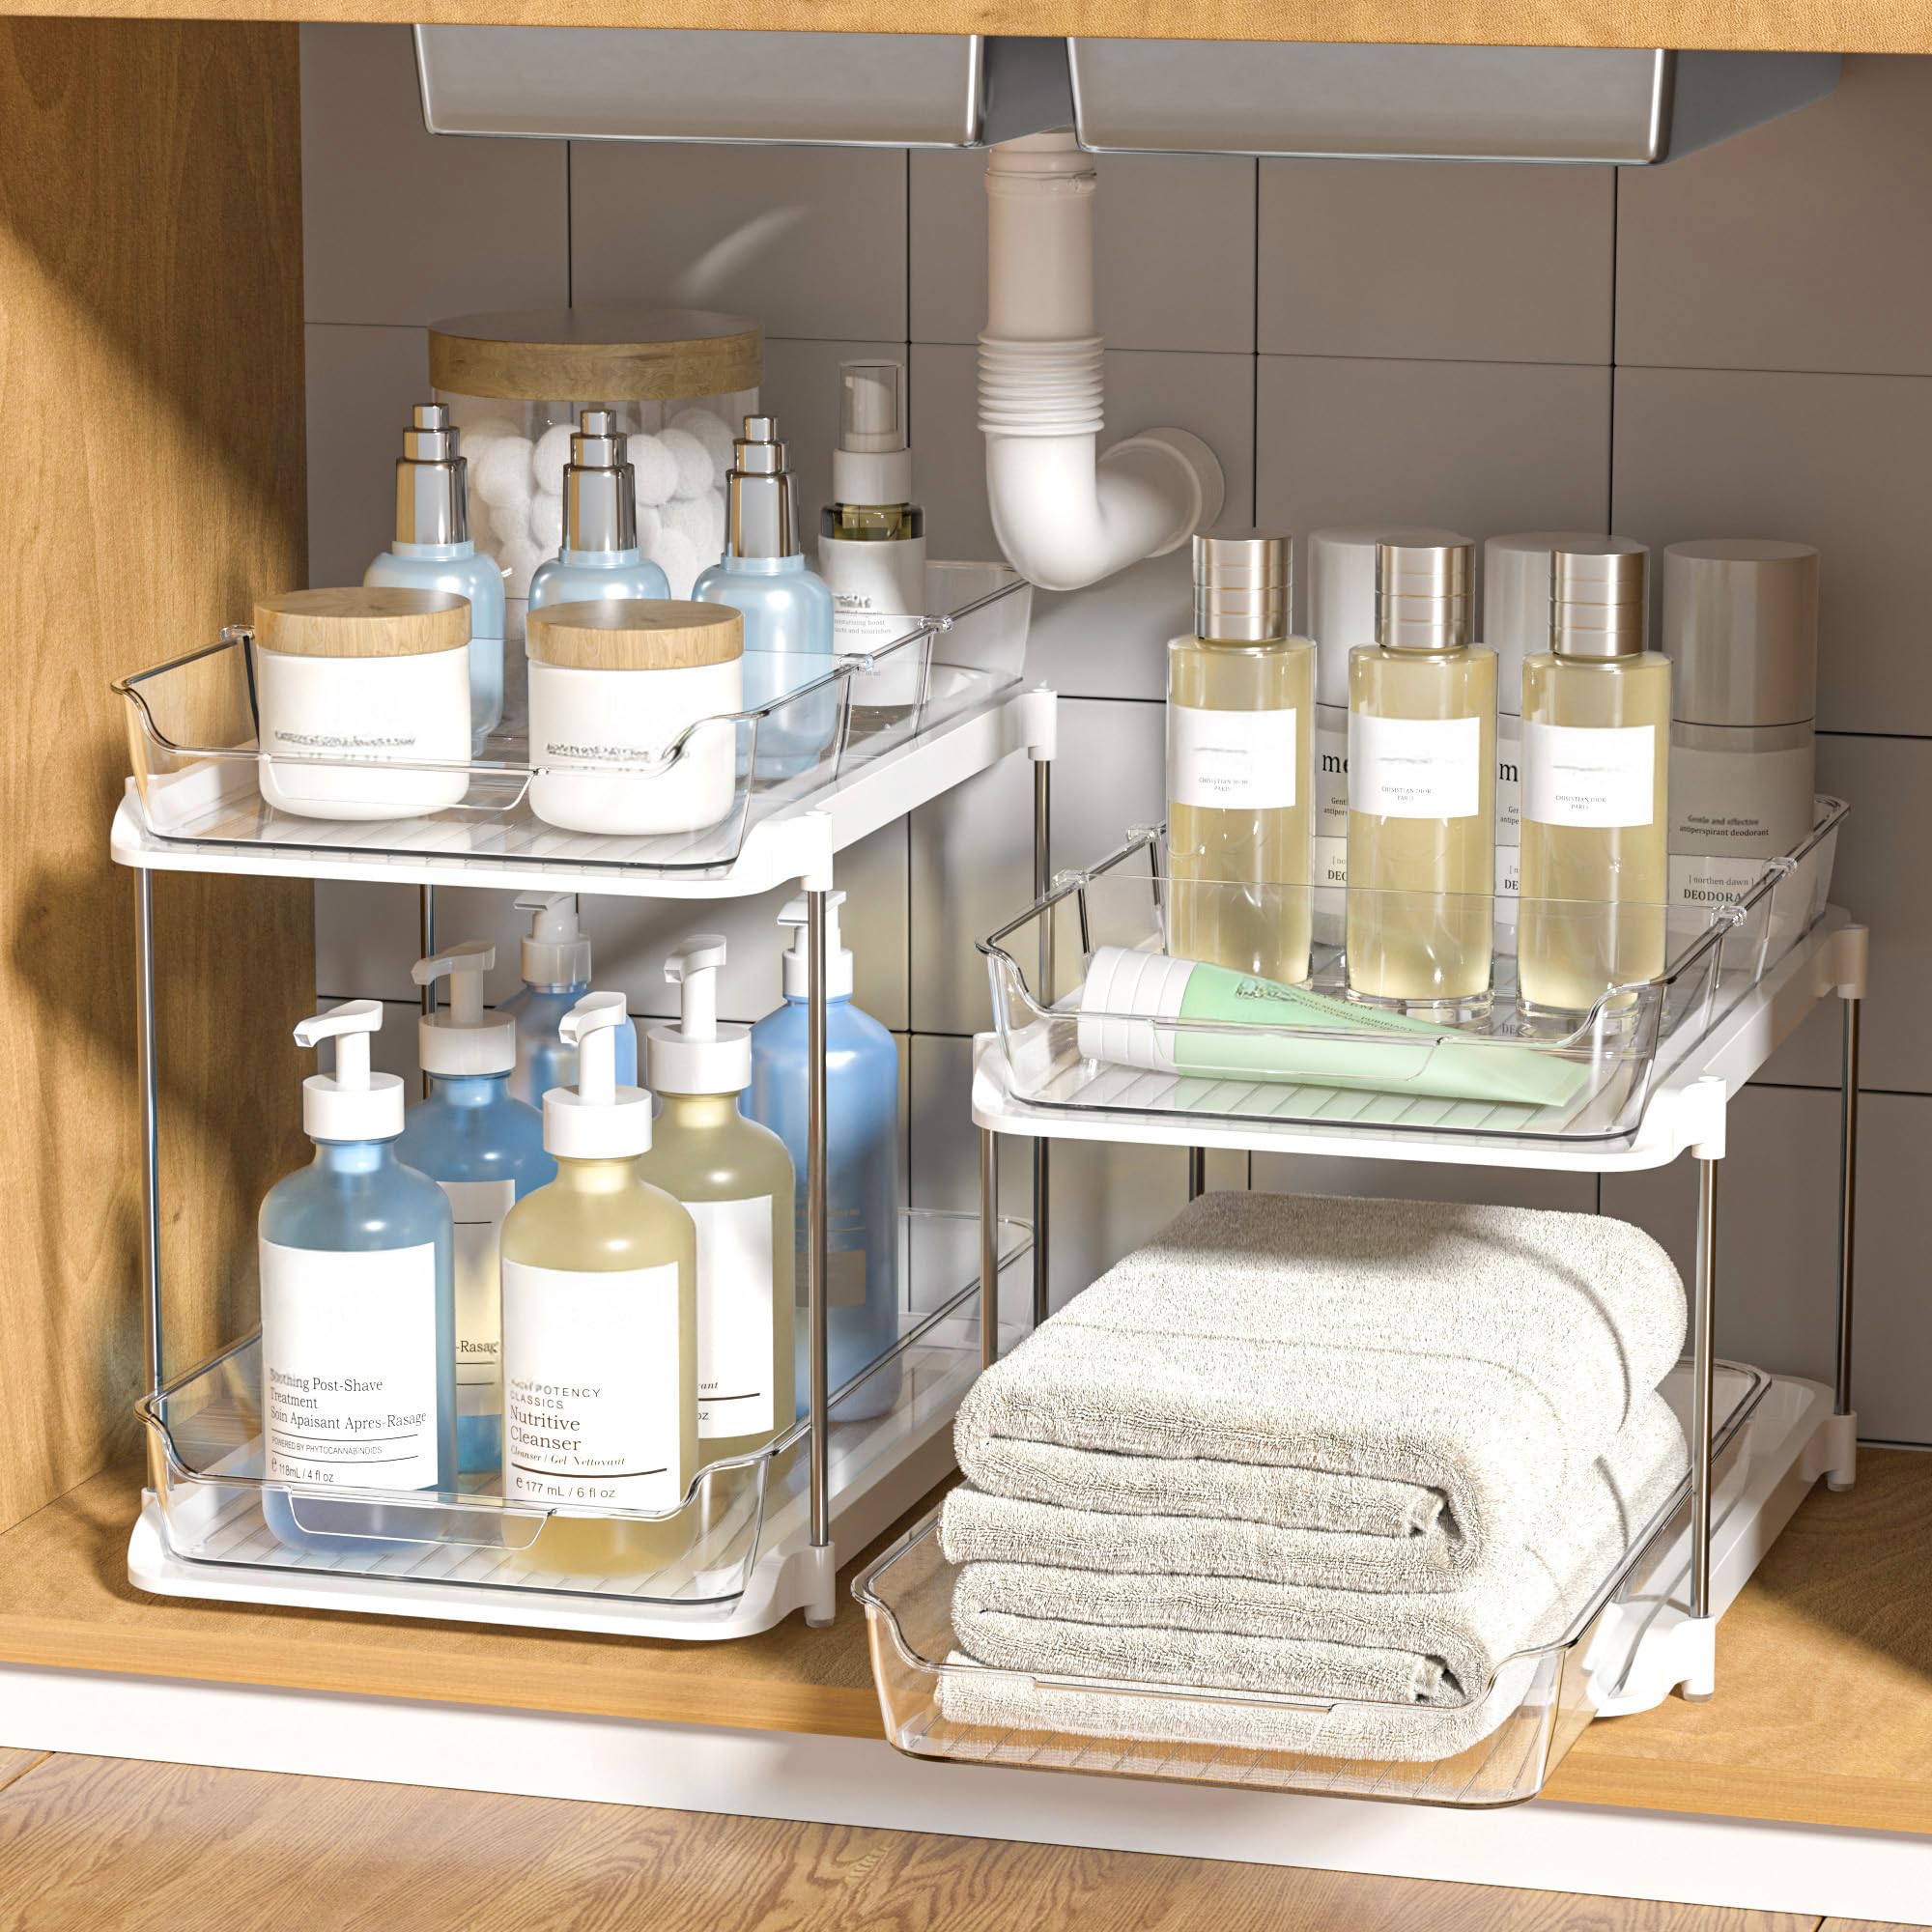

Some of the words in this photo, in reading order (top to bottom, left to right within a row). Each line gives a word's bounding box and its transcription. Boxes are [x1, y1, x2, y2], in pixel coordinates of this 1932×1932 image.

[1687, 814, 1710, 824] Gentle
[1712, 817, 1725, 826] and
[1726, 818, 1759, 827] effective
[1679, 825, 1729, 837] antiperspirant
[1725, 877, 1748, 886] dawn
[1684, 889, 1743, 903] DEODORA
[312, 1377, 384, 1392] Post-Shave
[270, 1385, 319, 1409] Treatment
[510, 1390, 564, 1409] CLASSICS
[270, 1405, 288, 1423] Soin
[290, 1411, 340, 1430] Apaisant
[345, 1411, 427, 1433] Apres-Rasage
[510, 1405, 581, 1432] Nutritive
[270, 1435, 296, 1450] POWERED
[306, 1444, 383, 1455] PHYTOCANNABINOIDS
[510, 1425, 582, 1451] Cleanser
[510, 1444, 542, 1462] Cleanser
[551, 1454, 568, 1465] Gel
[278, 1463, 301, 1479] 118mL
[307, 1469, 313, 1481] 4
[315, 1469, 321, 1481] fl
[323, 1473, 334, 1483] oz
[526, 1480, 543, 1493] 177
[547, 1485, 565, 1497] mL
[577, 1487, 584, 1498] 6
[589, 1487, 596, 1498] fl
[600, 1490, 616, 1498] oz
